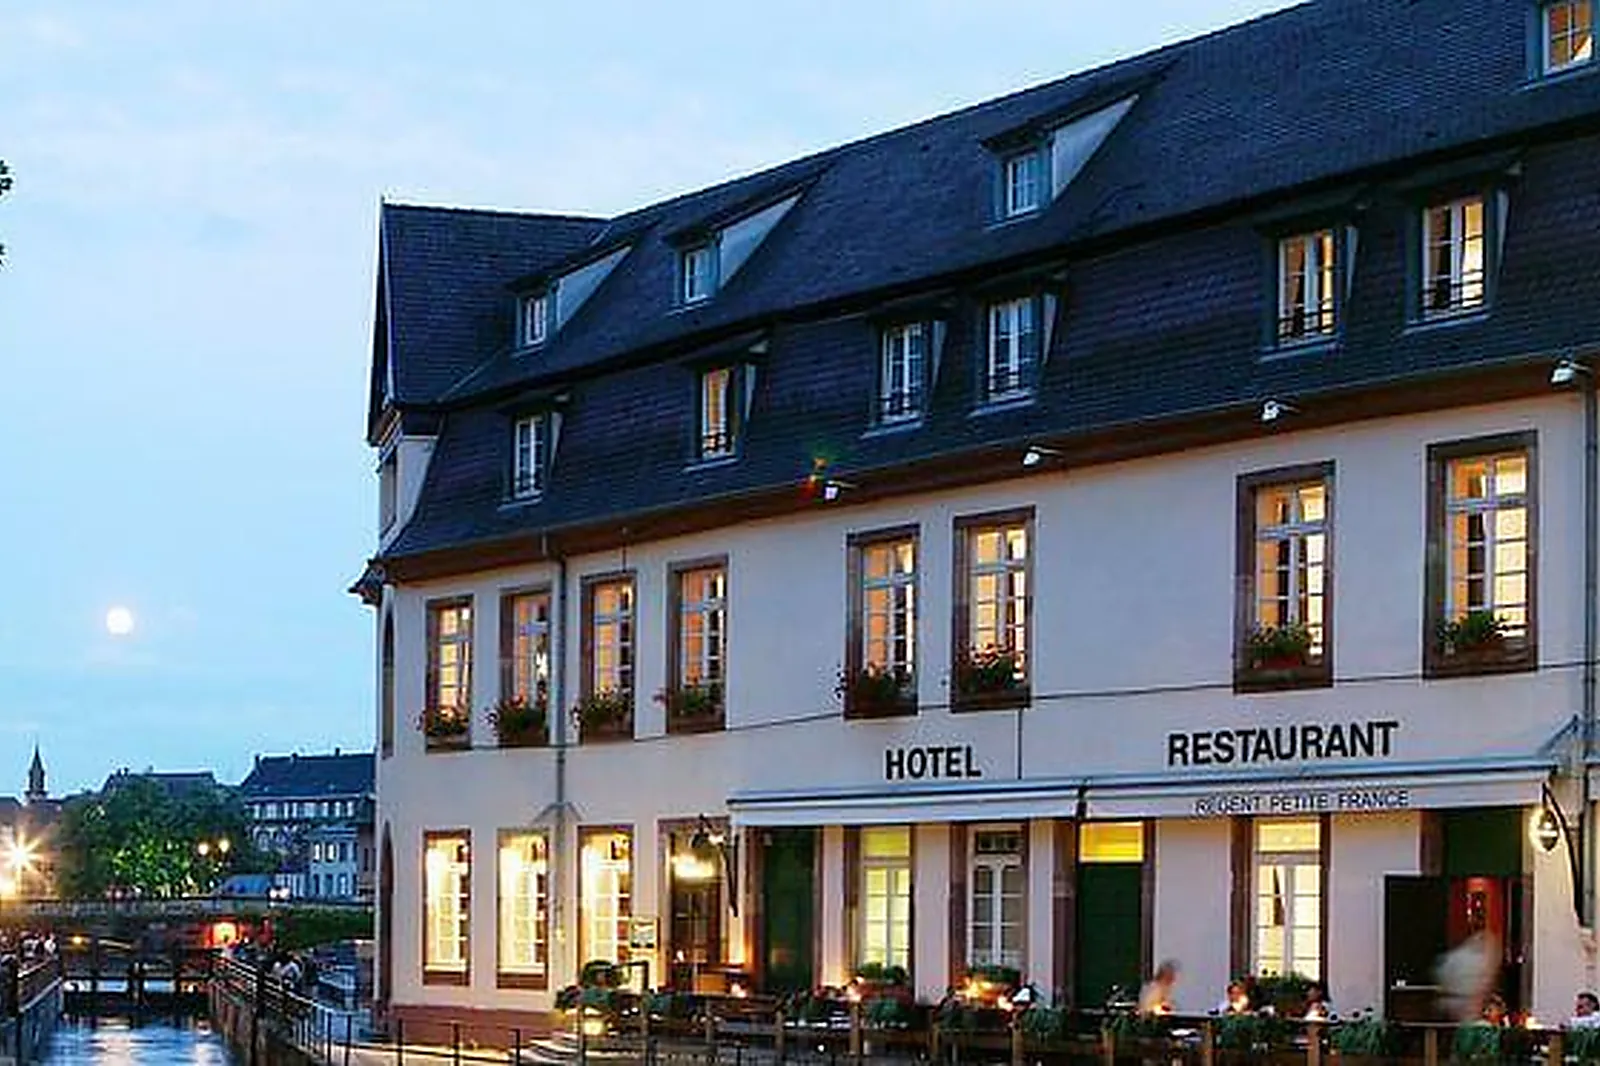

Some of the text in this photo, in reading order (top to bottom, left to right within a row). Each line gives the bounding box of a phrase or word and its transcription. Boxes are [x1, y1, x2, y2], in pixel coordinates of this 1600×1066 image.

[1168, 721, 1398, 766] RESTAURANT
[886, 745, 981, 780] HOTEL
[1270, 794, 1329, 811] PETITE
[1339, 790, 1409, 809] FRANCE
